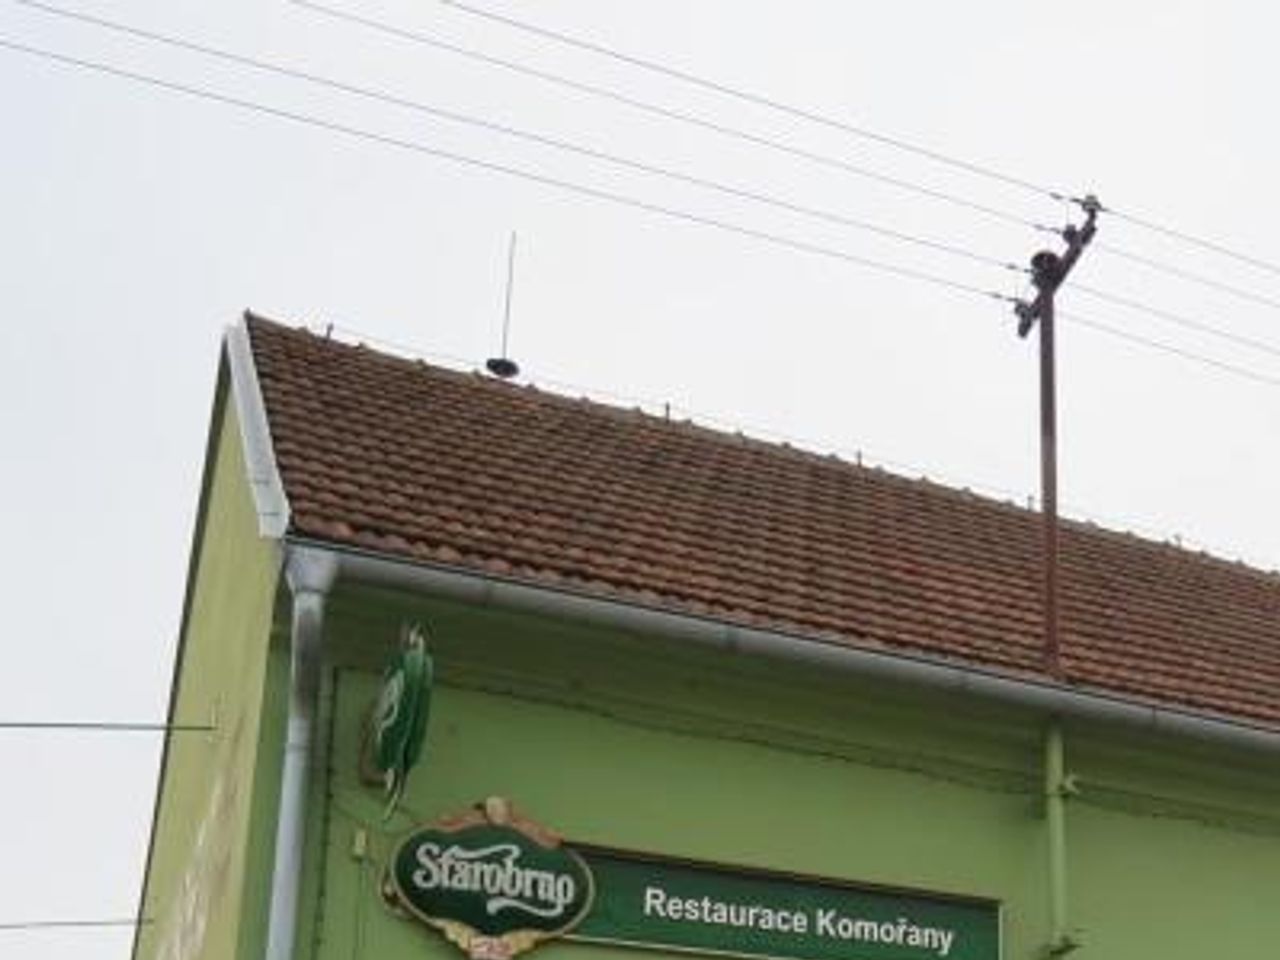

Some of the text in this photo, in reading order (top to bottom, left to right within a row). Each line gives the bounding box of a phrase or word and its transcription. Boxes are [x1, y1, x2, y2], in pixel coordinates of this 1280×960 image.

[412, 841, 575, 917] Starobrno
[643, 886, 955, 955] Restaurace Komořany
